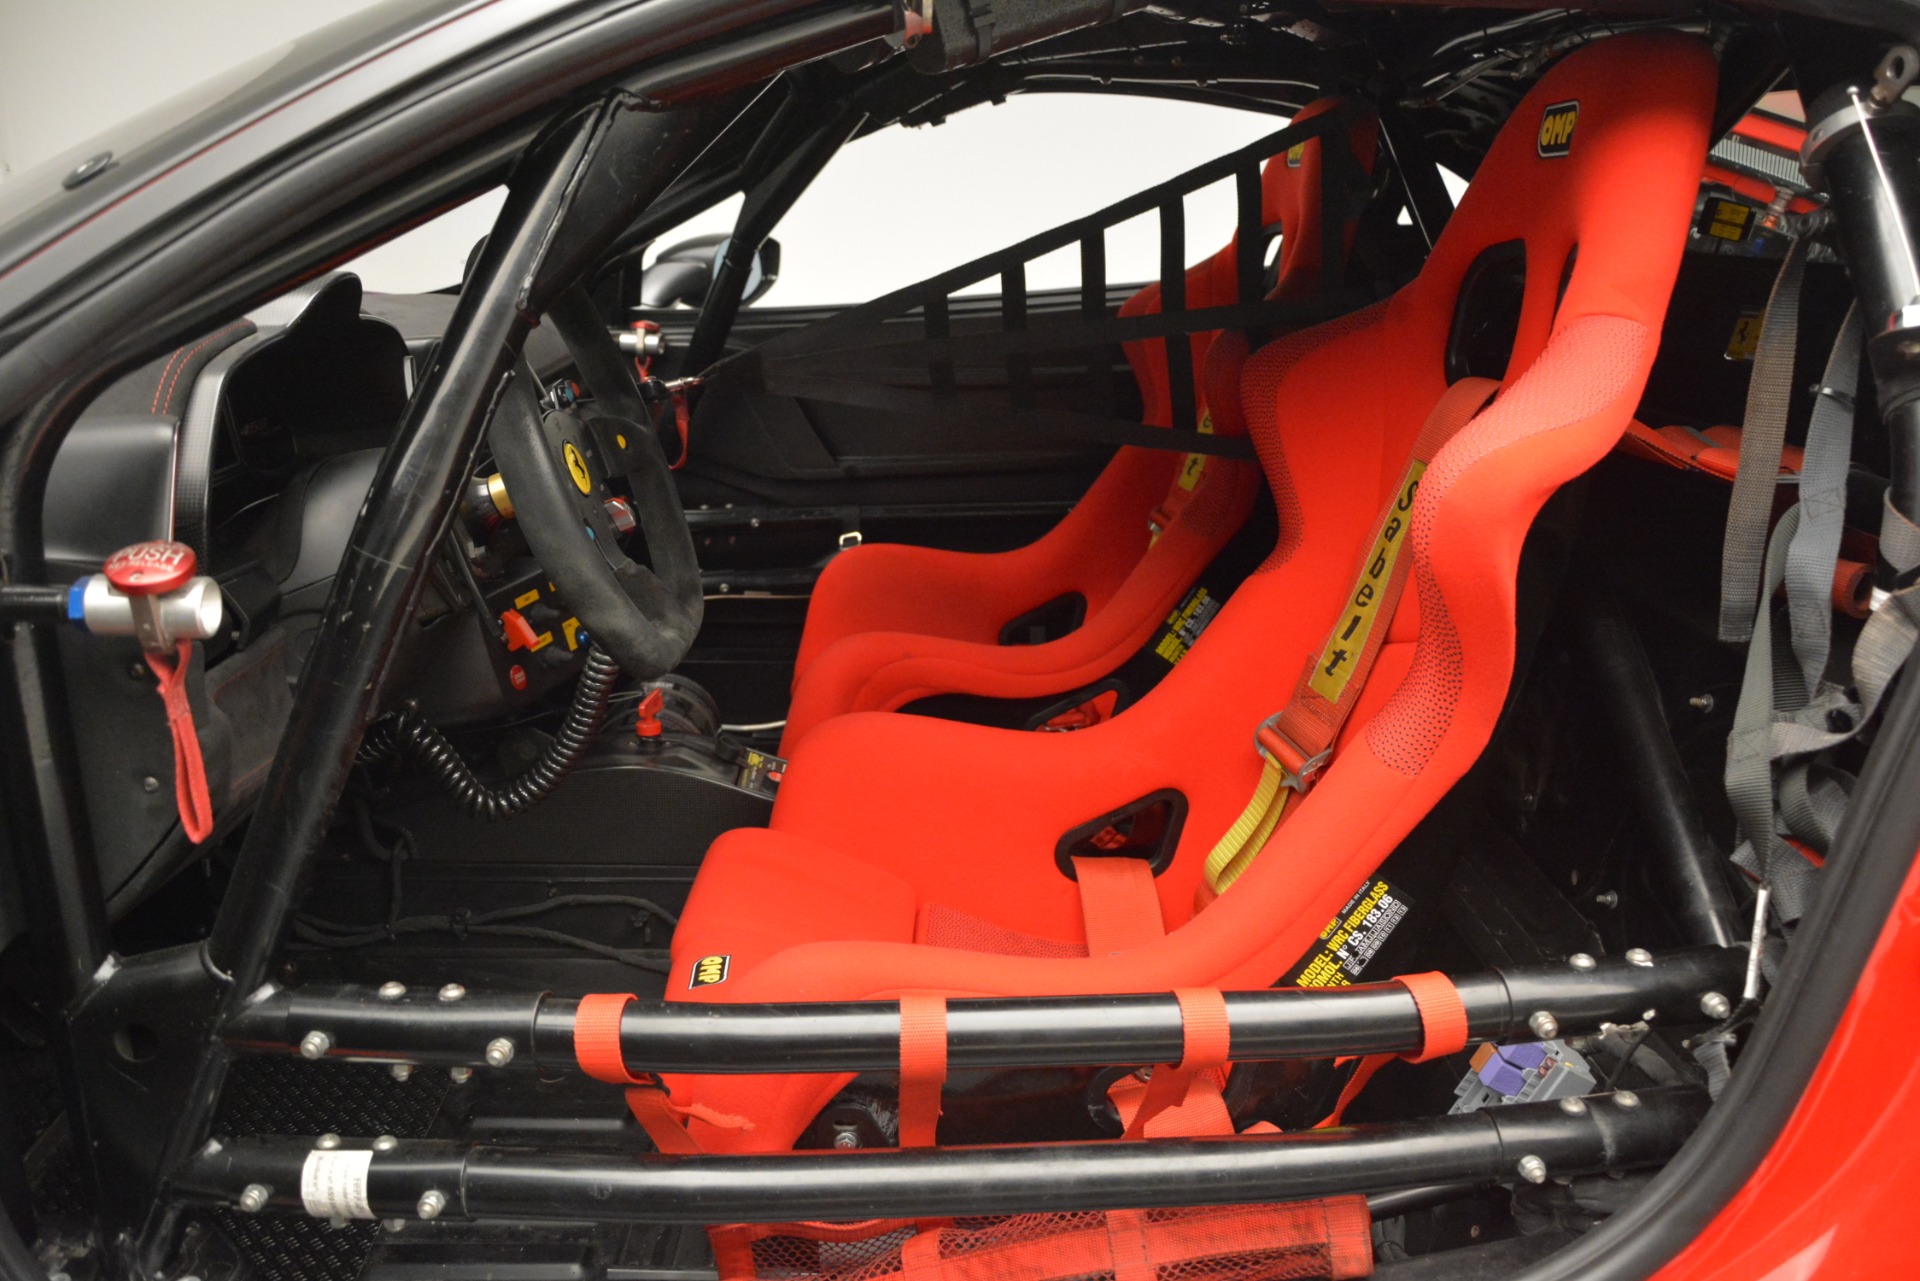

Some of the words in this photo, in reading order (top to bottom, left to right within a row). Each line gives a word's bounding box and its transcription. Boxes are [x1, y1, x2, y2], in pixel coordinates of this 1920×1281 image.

[1541, 111, 1576, 146] OMP
[112, 547, 184, 566] PUSH
[1325, 480, 1420, 677] Sabelt
[1341, 900, 1355, 914] MADE
[1358, 880, 1370, 894] ITALY
[1296, 950, 1333, 987] MODEL:
[1327, 930, 1349, 952] WRC
[1343, 881, 1389, 932] FIBERGLASS
[1310, 961, 1342, 987] OMOL.
[1348, 930, 1366, 946] CS.
[1362, 893, 1393, 927] 183.06
[698, 956, 723, 984] OMP
[1328, 971, 1344, 986] NTH
